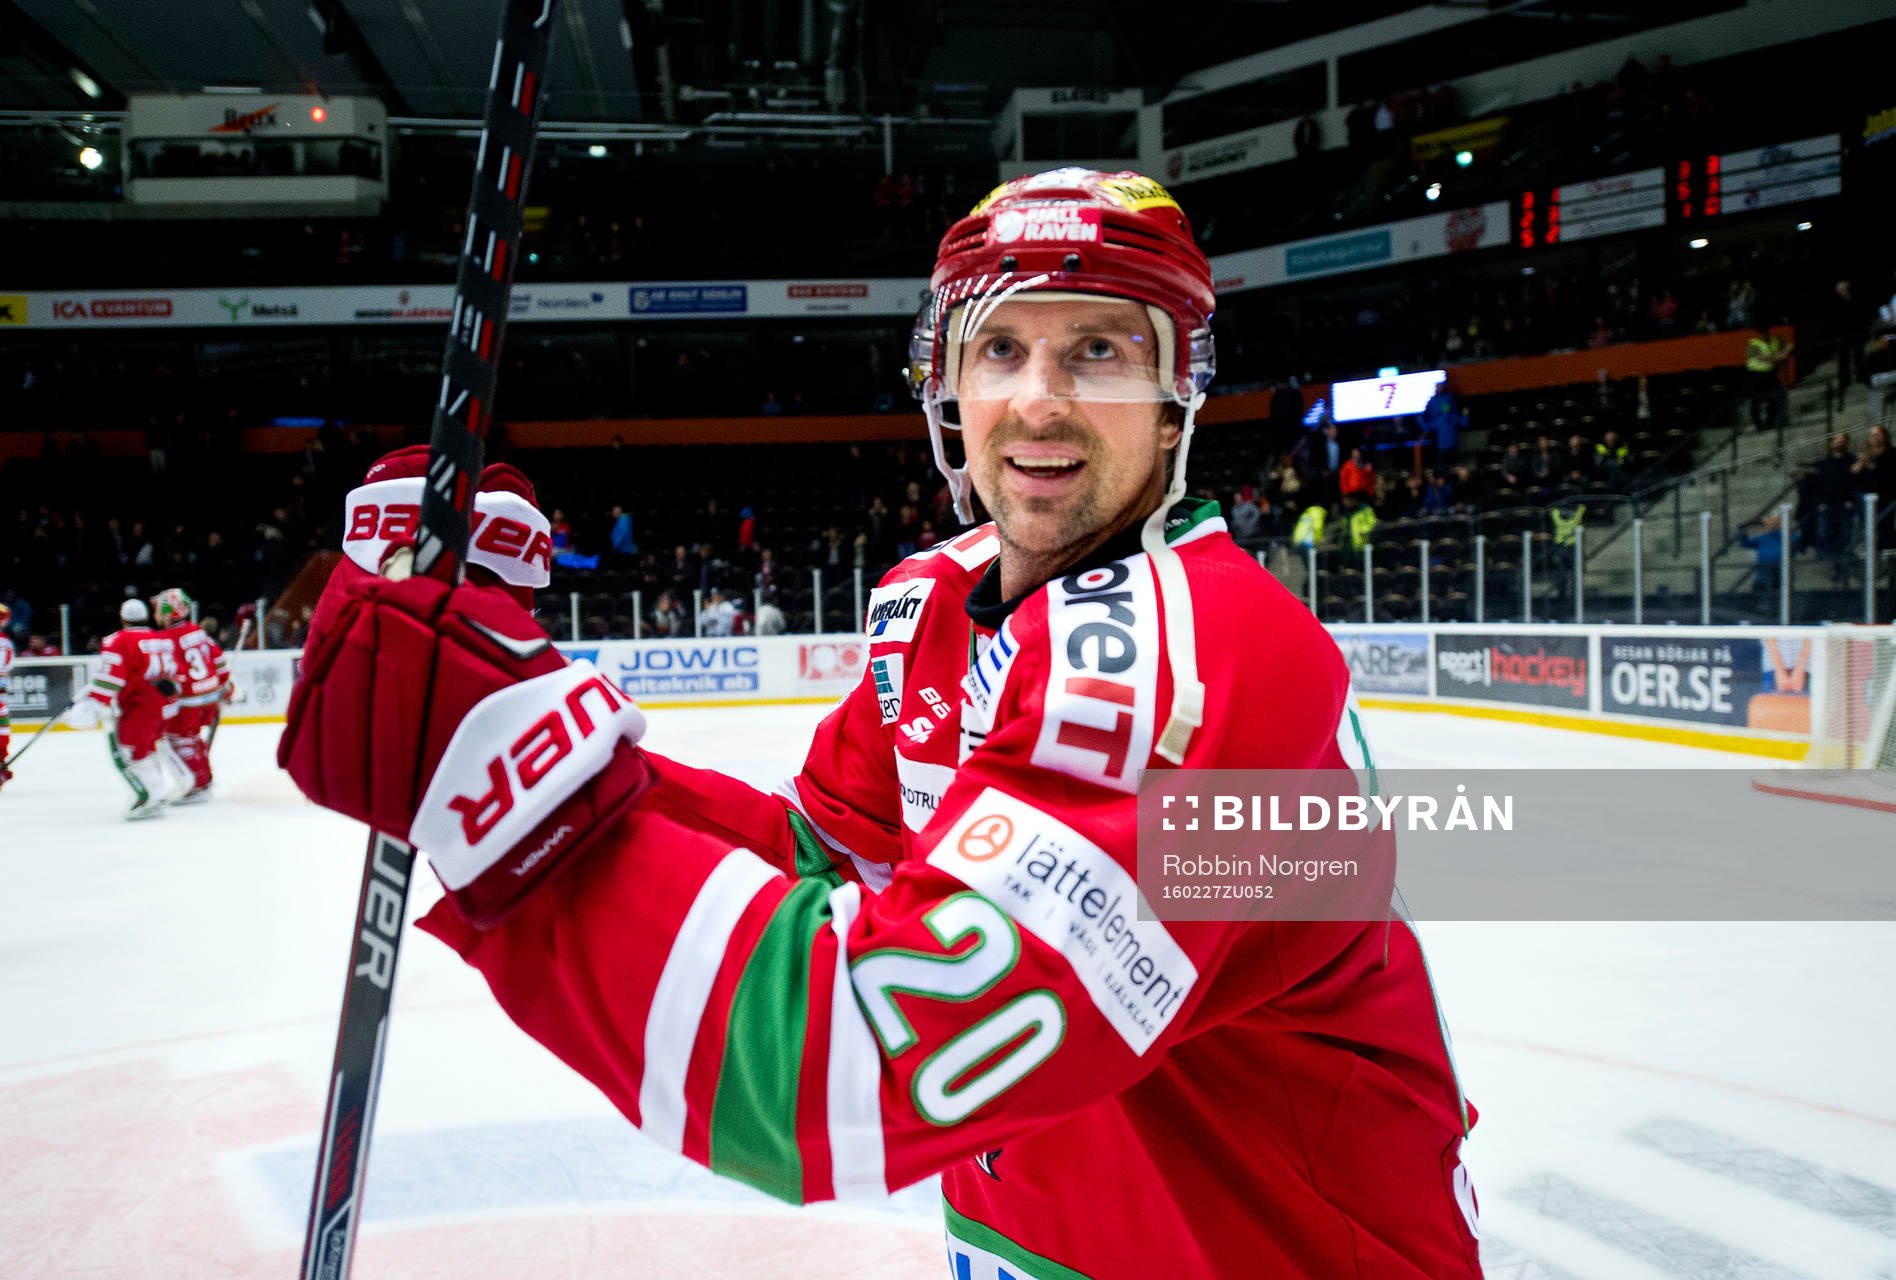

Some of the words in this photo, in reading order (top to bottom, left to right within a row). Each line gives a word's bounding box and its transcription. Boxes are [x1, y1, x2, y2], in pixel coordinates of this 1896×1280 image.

[53, 302, 86, 318] ICA
[1378, 383, 1398, 409] 7
[620, 648, 758, 671] JOWIC
[1491, 646, 1586, 697] hockey
[624, 675, 718, 694] elteknik
[722, 674, 754, 691] ab
[1611, 661, 1733, 713] OER.SE
[1003, 875, 1037, 904] TAK
[1016, 833, 1185, 1018] lättelement
[849, 890, 1068, 1127] 20
